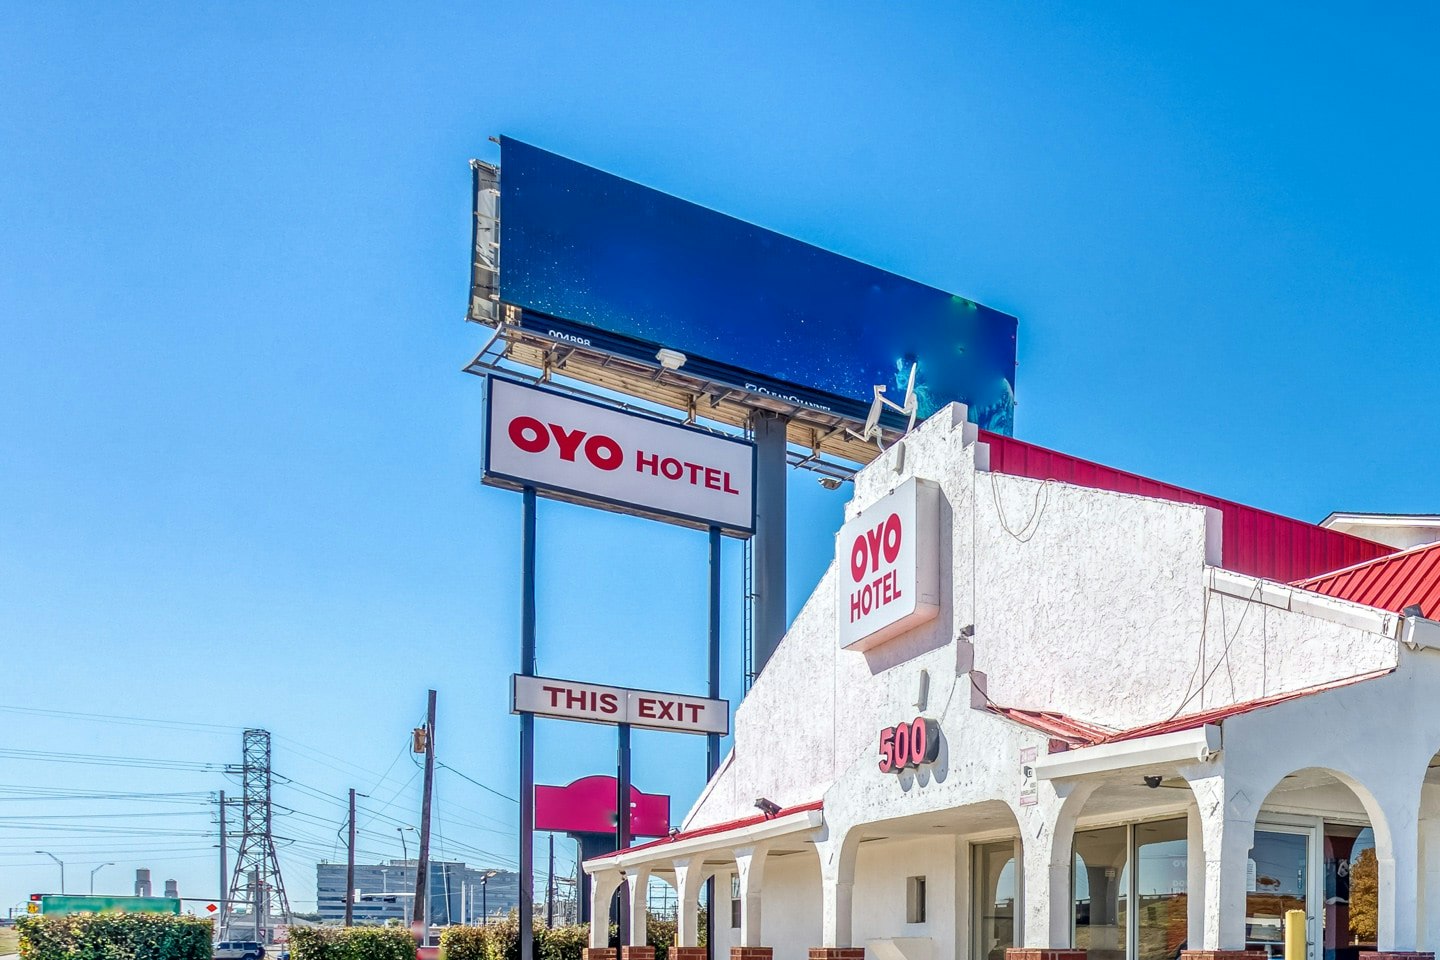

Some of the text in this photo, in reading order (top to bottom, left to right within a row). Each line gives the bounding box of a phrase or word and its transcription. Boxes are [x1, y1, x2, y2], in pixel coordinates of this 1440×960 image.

[508, 416, 740, 495] OYO HOTEL
[851, 513, 902, 583] OYO
[850, 568, 902, 623] HOTEL
[543, 686, 705, 723] THIS EXIT
[879, 716, 927, 774] 500
